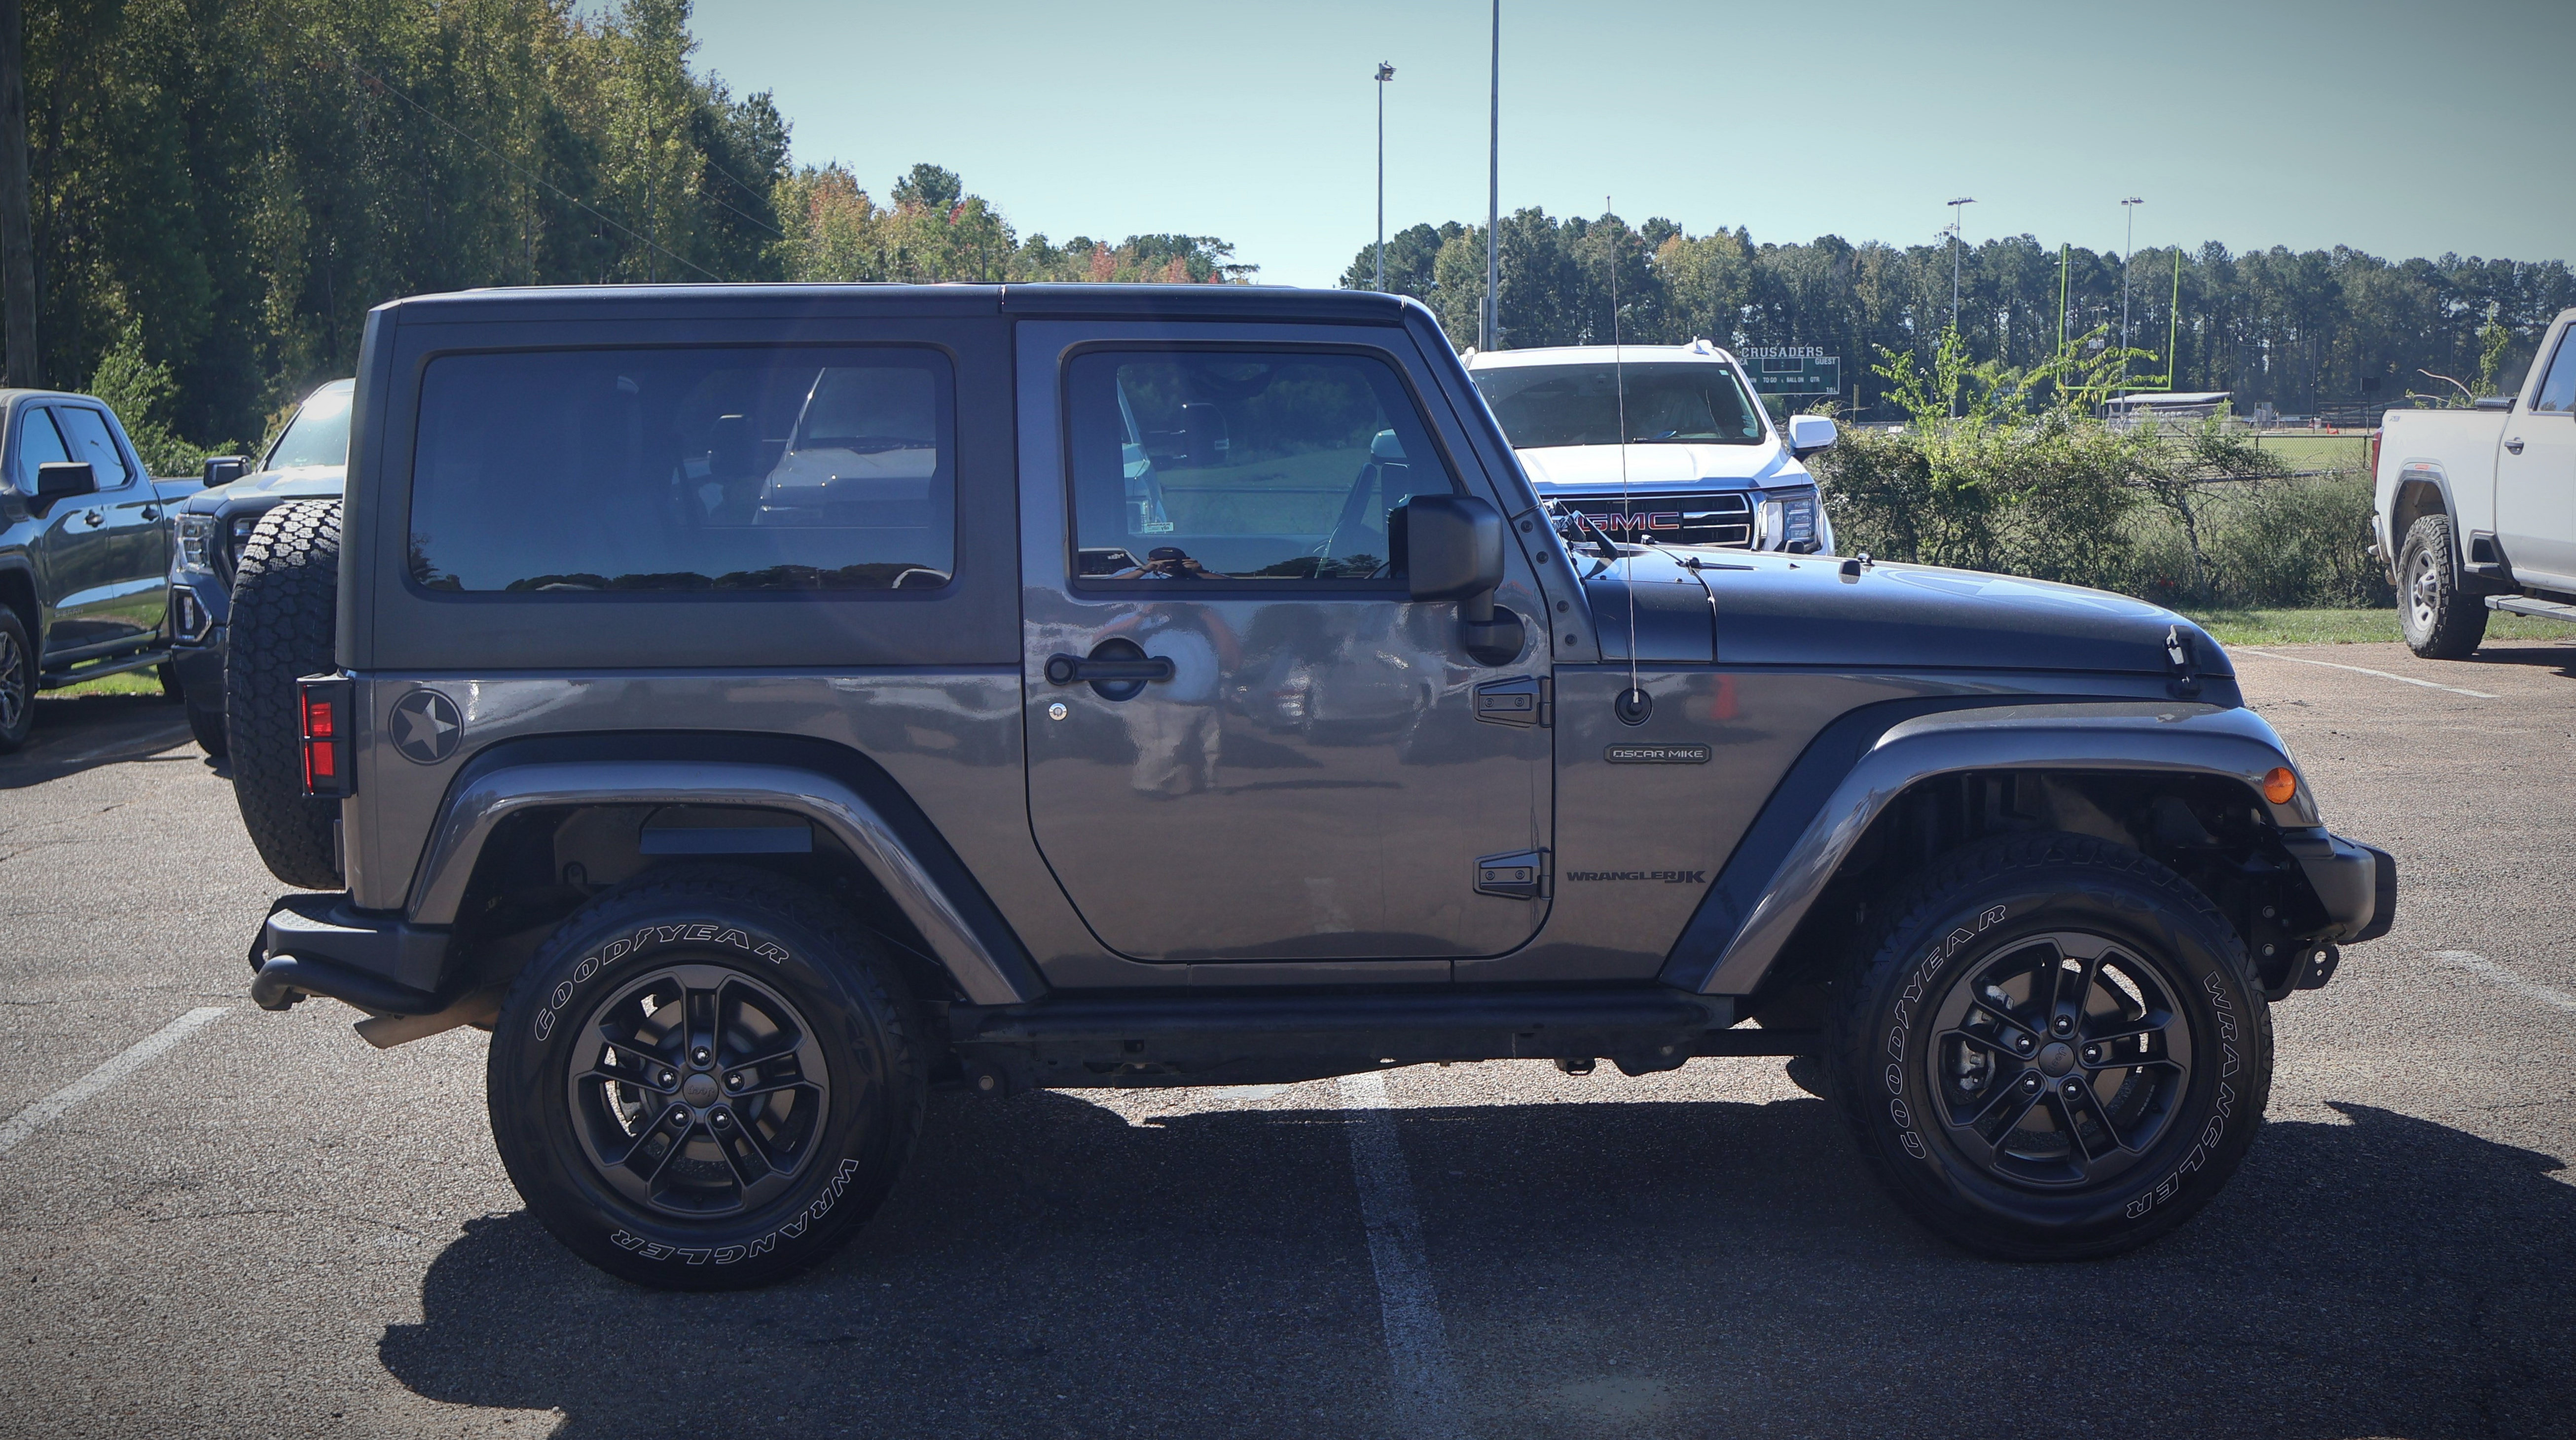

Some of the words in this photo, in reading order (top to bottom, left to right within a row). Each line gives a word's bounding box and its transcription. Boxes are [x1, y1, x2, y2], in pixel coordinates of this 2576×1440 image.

[1742, 347, 1823, 358] CRUSADERS
[1576, 512, 1679, 532] GMC
[535, 924, 789, 1041] GOODYEAR
[1886, 905, 2005, 1159] GOODYEAR
[2126, 971, 2240, 1219] WRANGLER
[611, 1159, 859, 1264] WRANGLER
